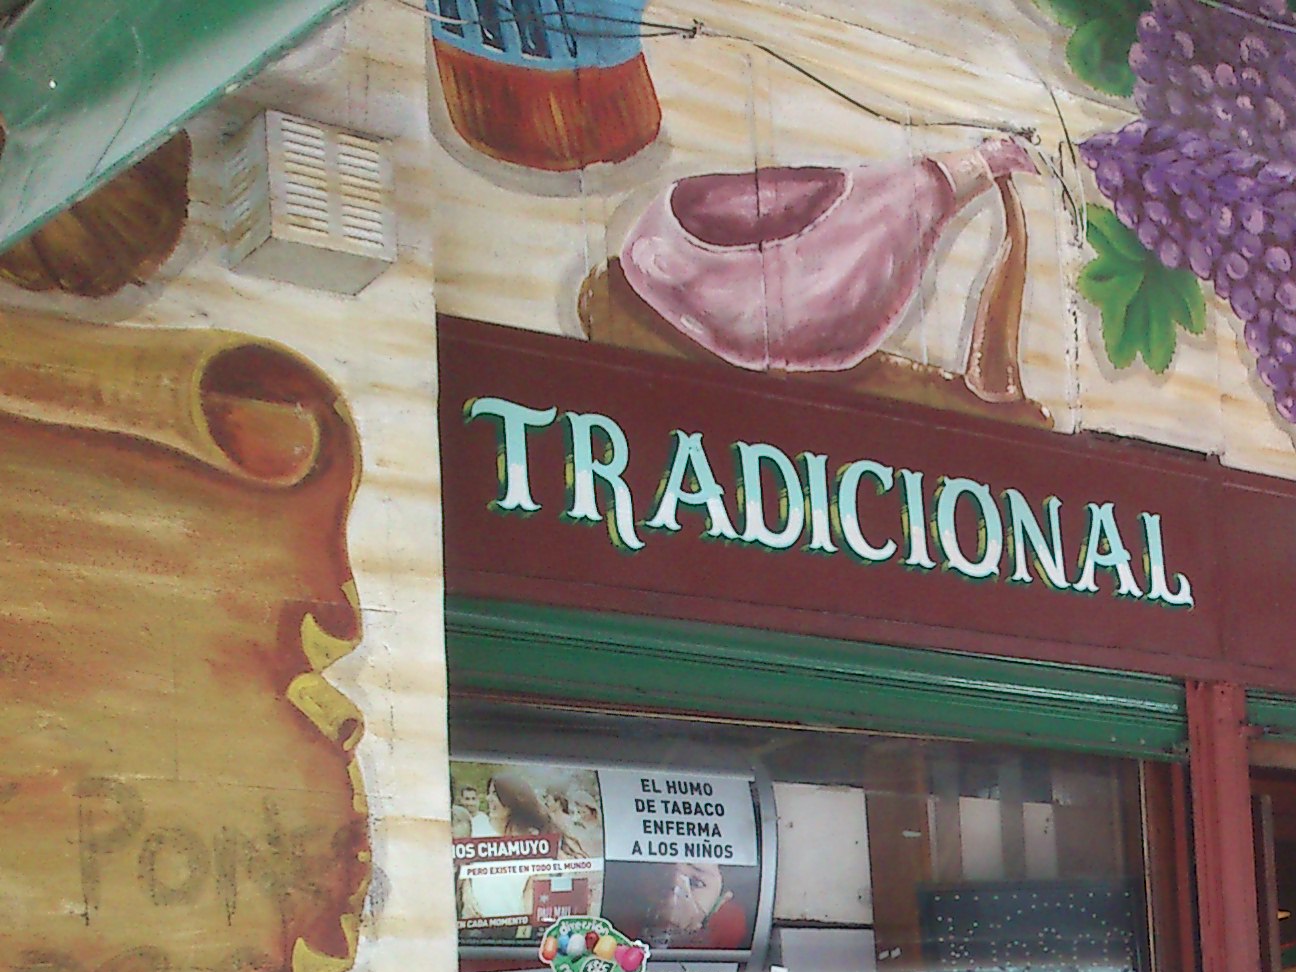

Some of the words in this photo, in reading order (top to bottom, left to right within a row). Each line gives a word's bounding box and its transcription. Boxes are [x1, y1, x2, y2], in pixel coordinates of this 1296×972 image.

[464, 395, 1195, 610] TRADICIONAL
[641, 779, 661, 793] EL
[666, 780, 713, 796] HUMO
[635, 799, 656, 813] DE
[661, 801, 725, 817] TABACO
[643, 819, 722, 837] ENFERMA
[477, 839, 549, 859] CHAMUYO
[631, 841, 642, 855] A
[649, 841, 679, 856] LOS
[684, 839, 734, 859] NIÑOS
[466, 868, 487, 876] PERO
[490, 867, 516, 875] EXISTE
[531, 864, 551, 872] TODO
[553, 863, 562, 871] EL
[564, 862, 592, 870] MUNDO
